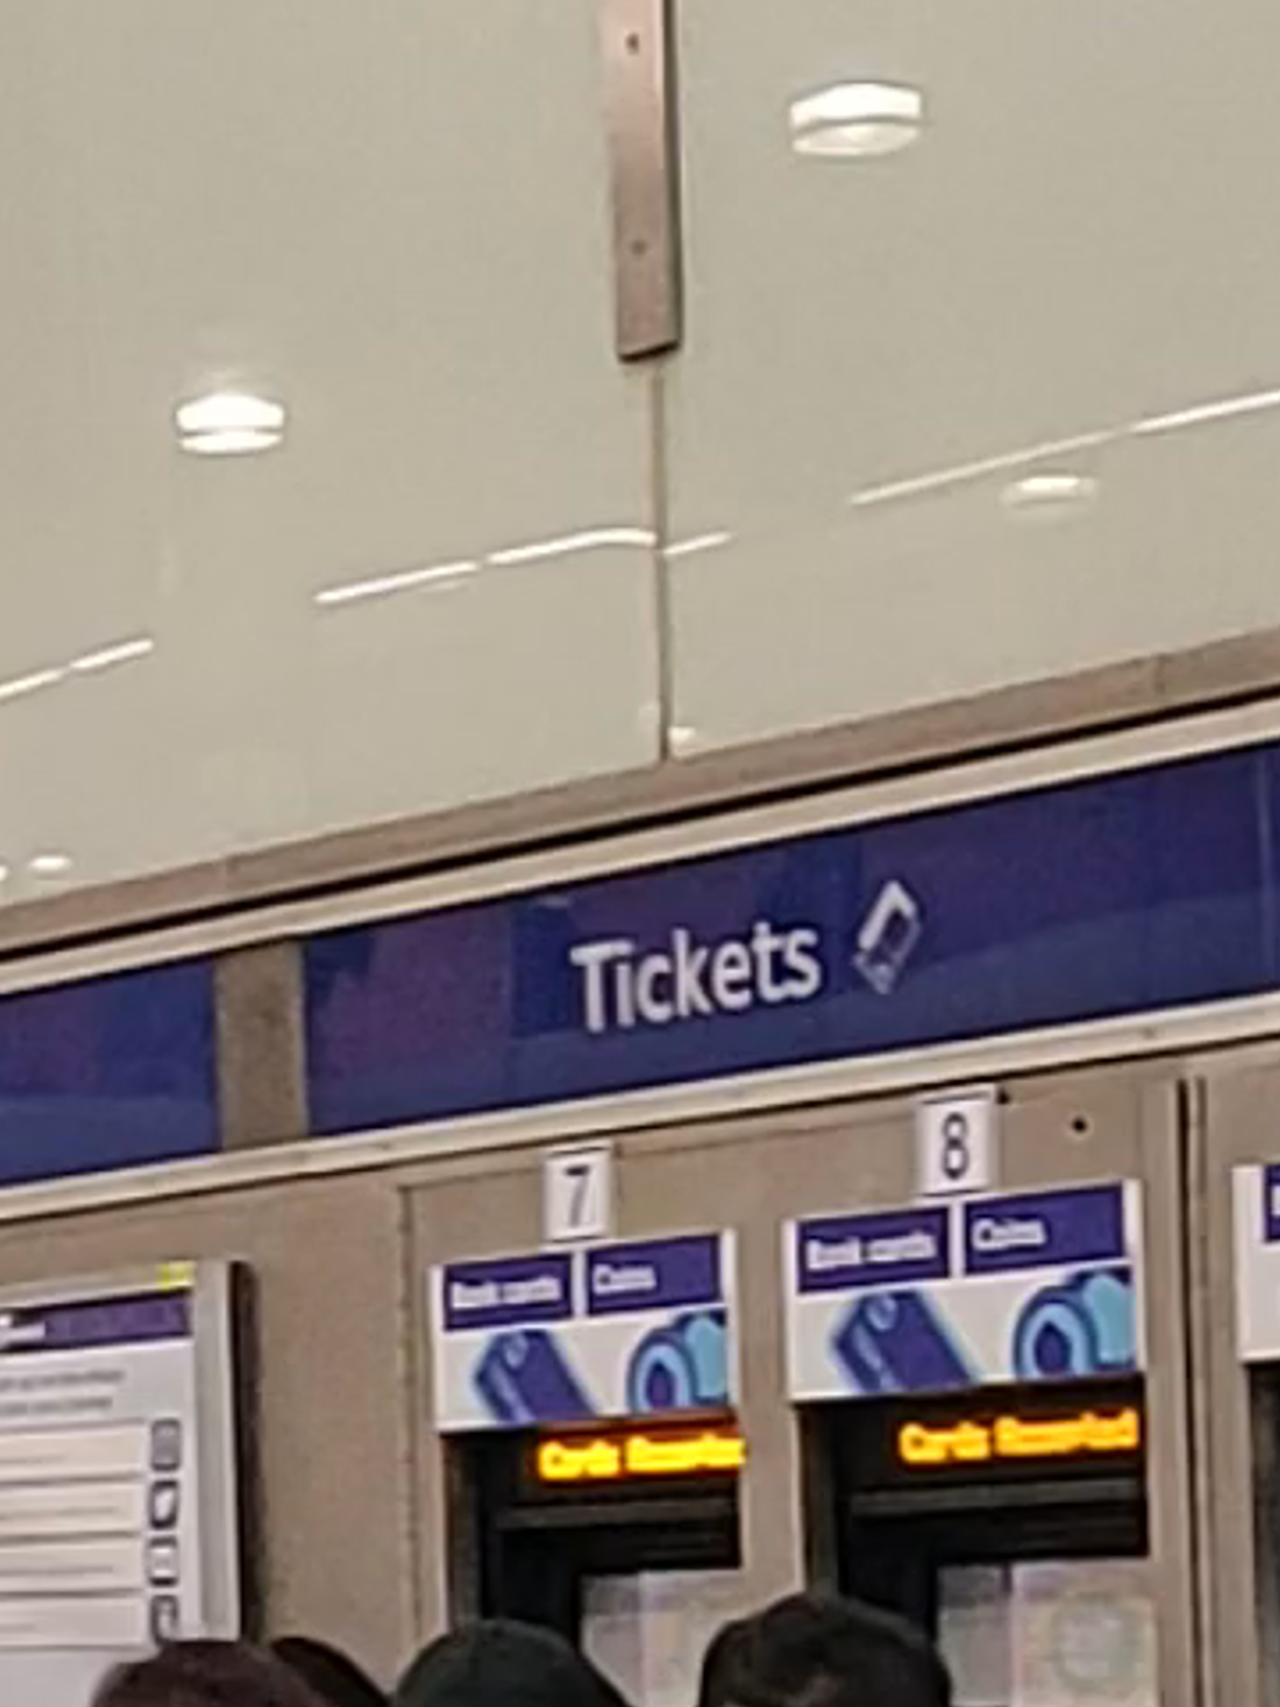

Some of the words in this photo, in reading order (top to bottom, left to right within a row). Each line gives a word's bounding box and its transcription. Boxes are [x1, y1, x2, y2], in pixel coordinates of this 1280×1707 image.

[570, 921, 822, 1033] Tickets
[943, 1111, 968, 1180] 8
[565, 1165, 590, 1229] 7
